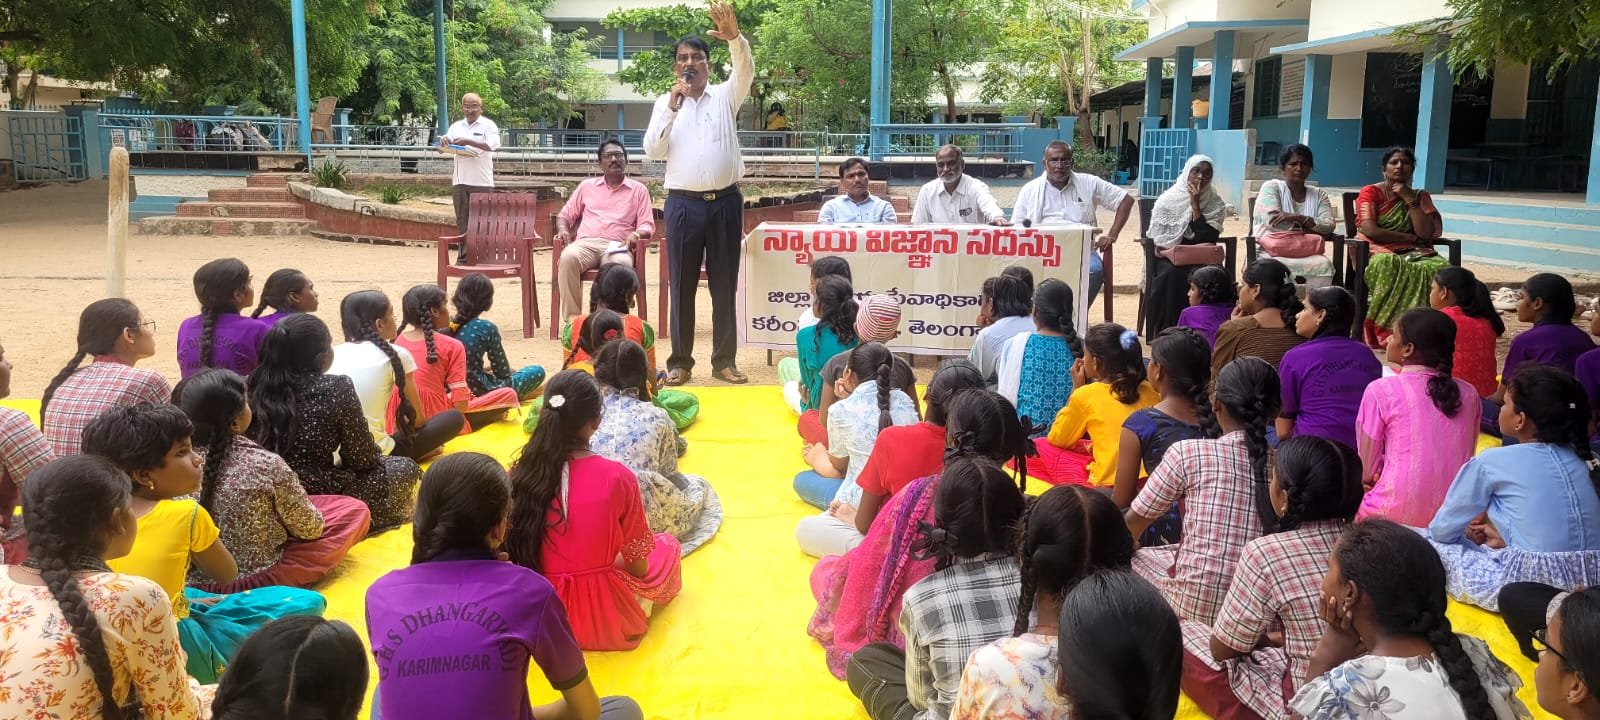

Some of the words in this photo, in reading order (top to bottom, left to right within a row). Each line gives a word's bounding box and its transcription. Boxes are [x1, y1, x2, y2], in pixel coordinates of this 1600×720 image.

[866, 230, 959, 268] విజ్ఞాన
[966, 228, 1062, 267] సదస్సు
[908, 319, 981, 337] తెలంగా
[396, 654, 491, 679] KARIMNAGAR
